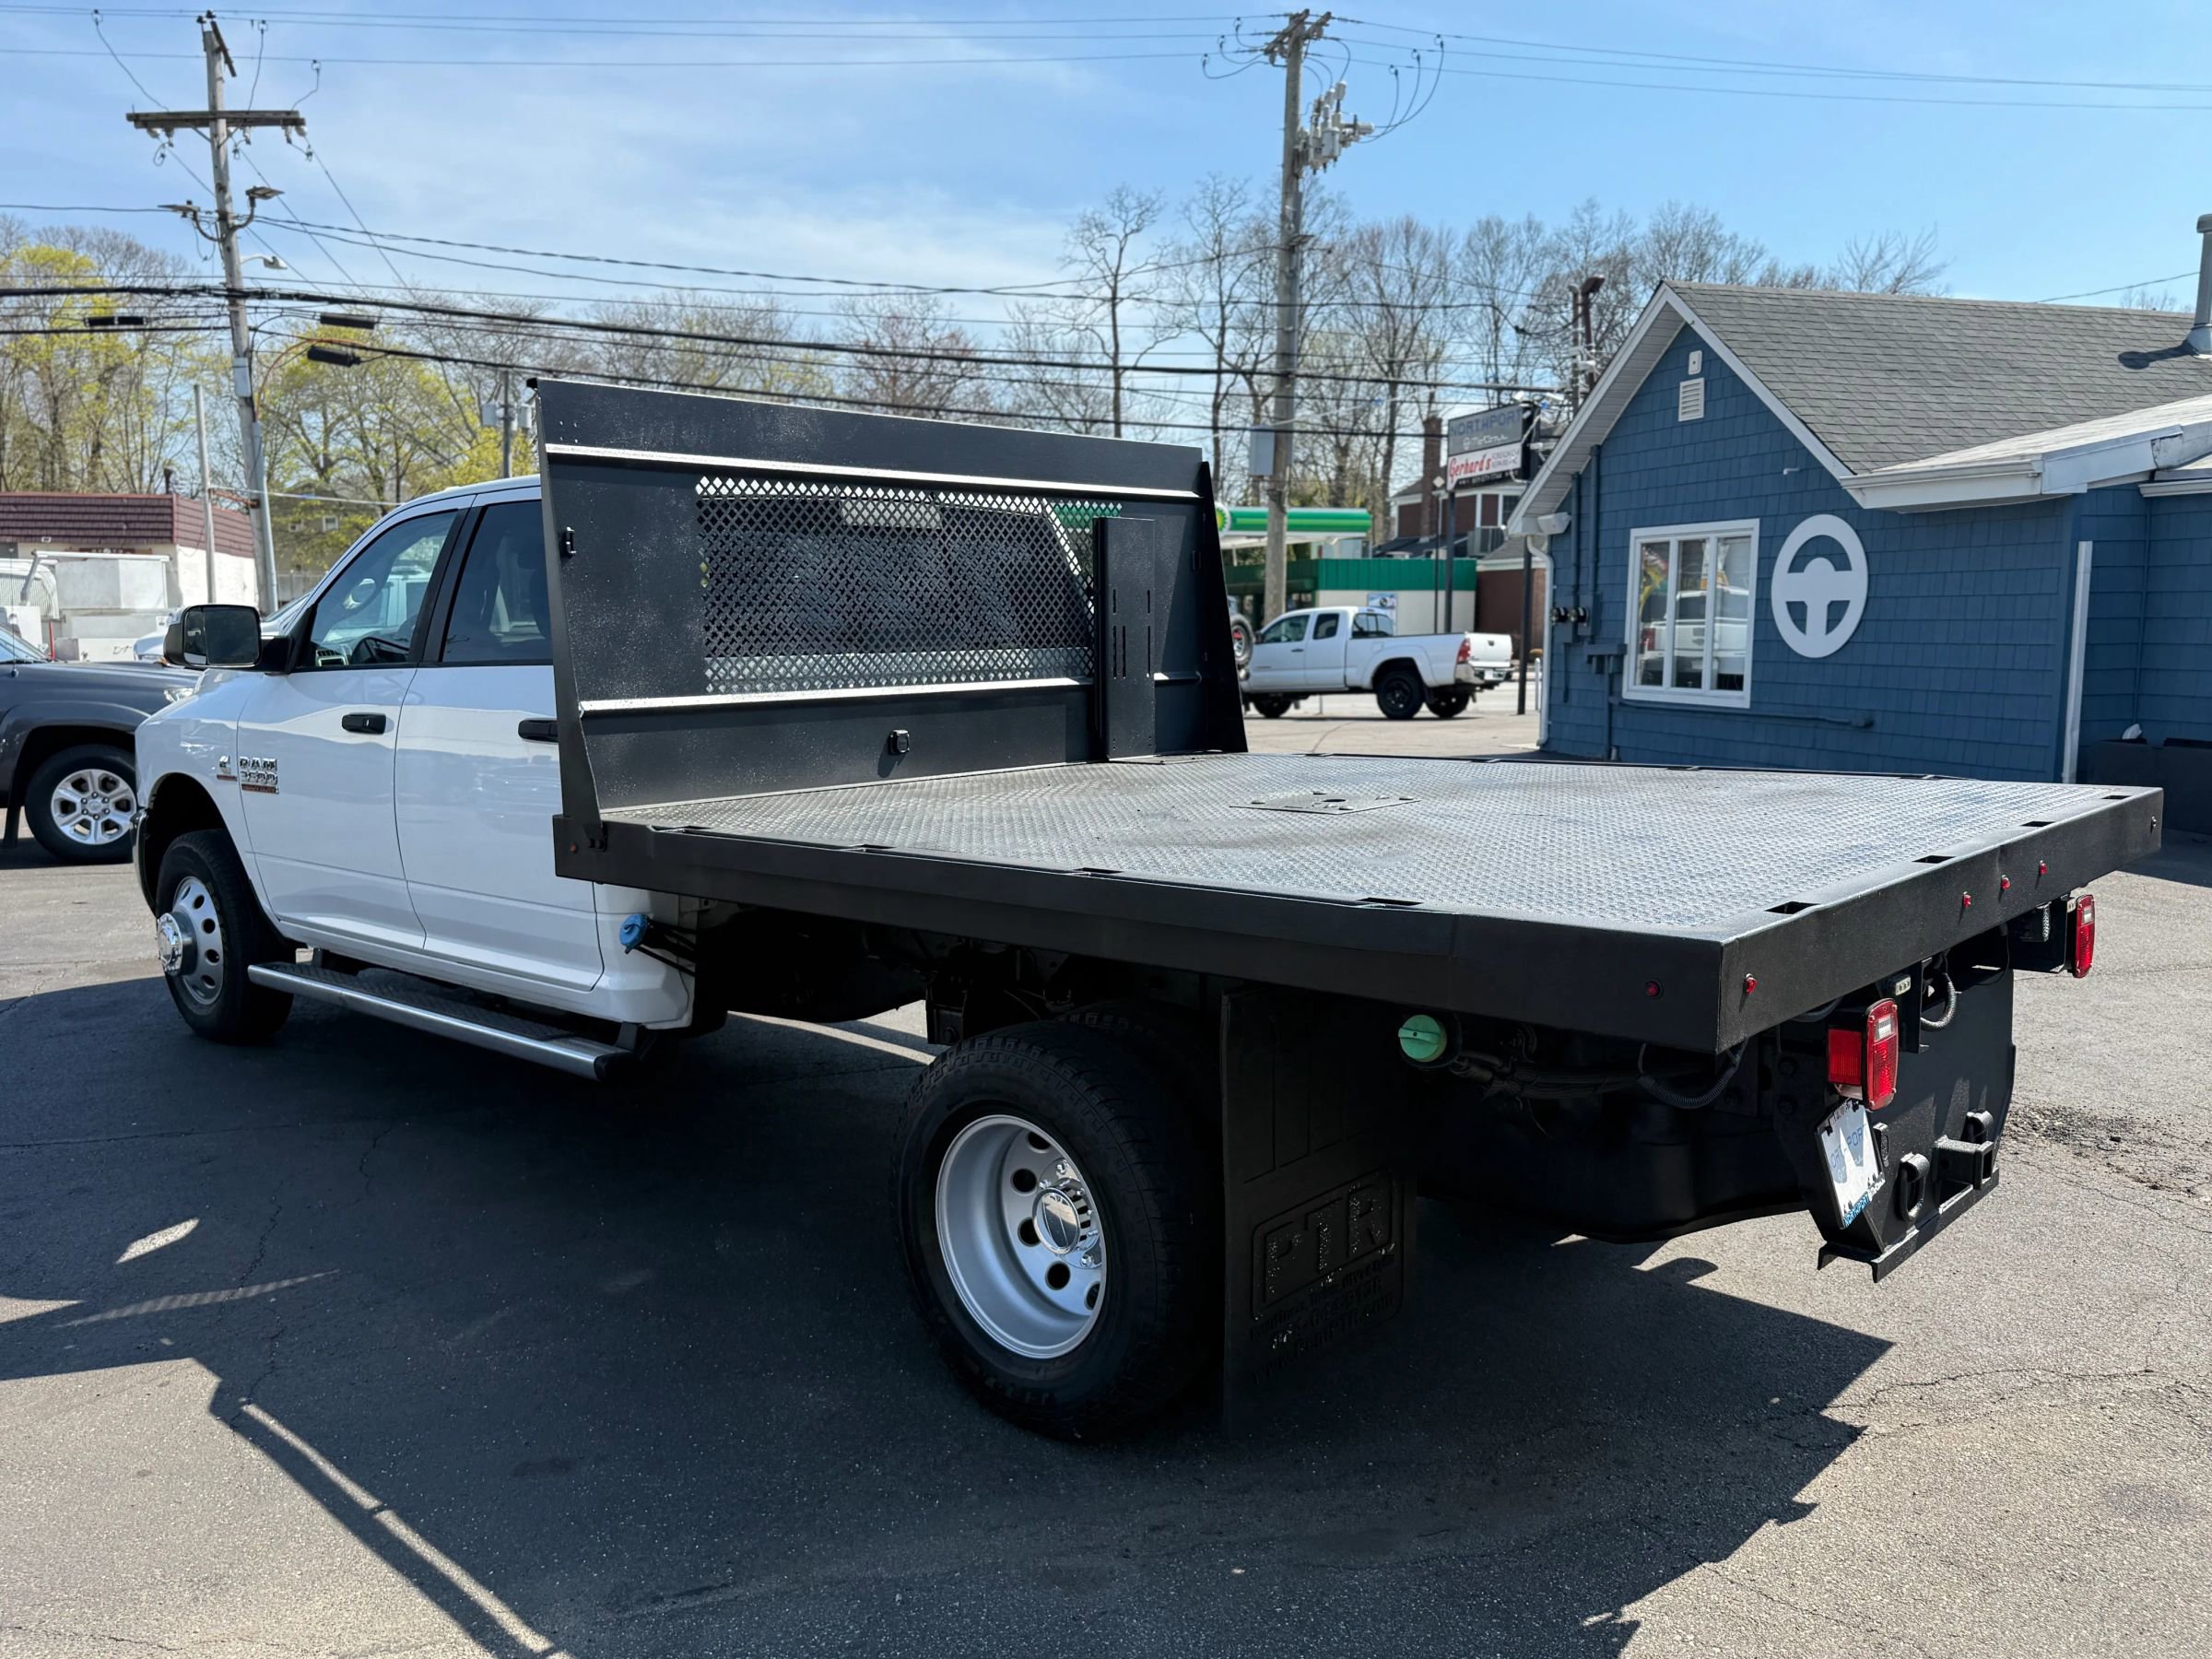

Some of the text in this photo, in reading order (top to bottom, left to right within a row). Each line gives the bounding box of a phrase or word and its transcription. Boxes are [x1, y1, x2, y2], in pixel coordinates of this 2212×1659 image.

[1450, 408, 1522, 437] NORTHPORT
[1448, 453, 1492, 484] Gerhard's
[239, 756, 277, 771] RAM
[1264, 1183, 1385, 1302] PTR
